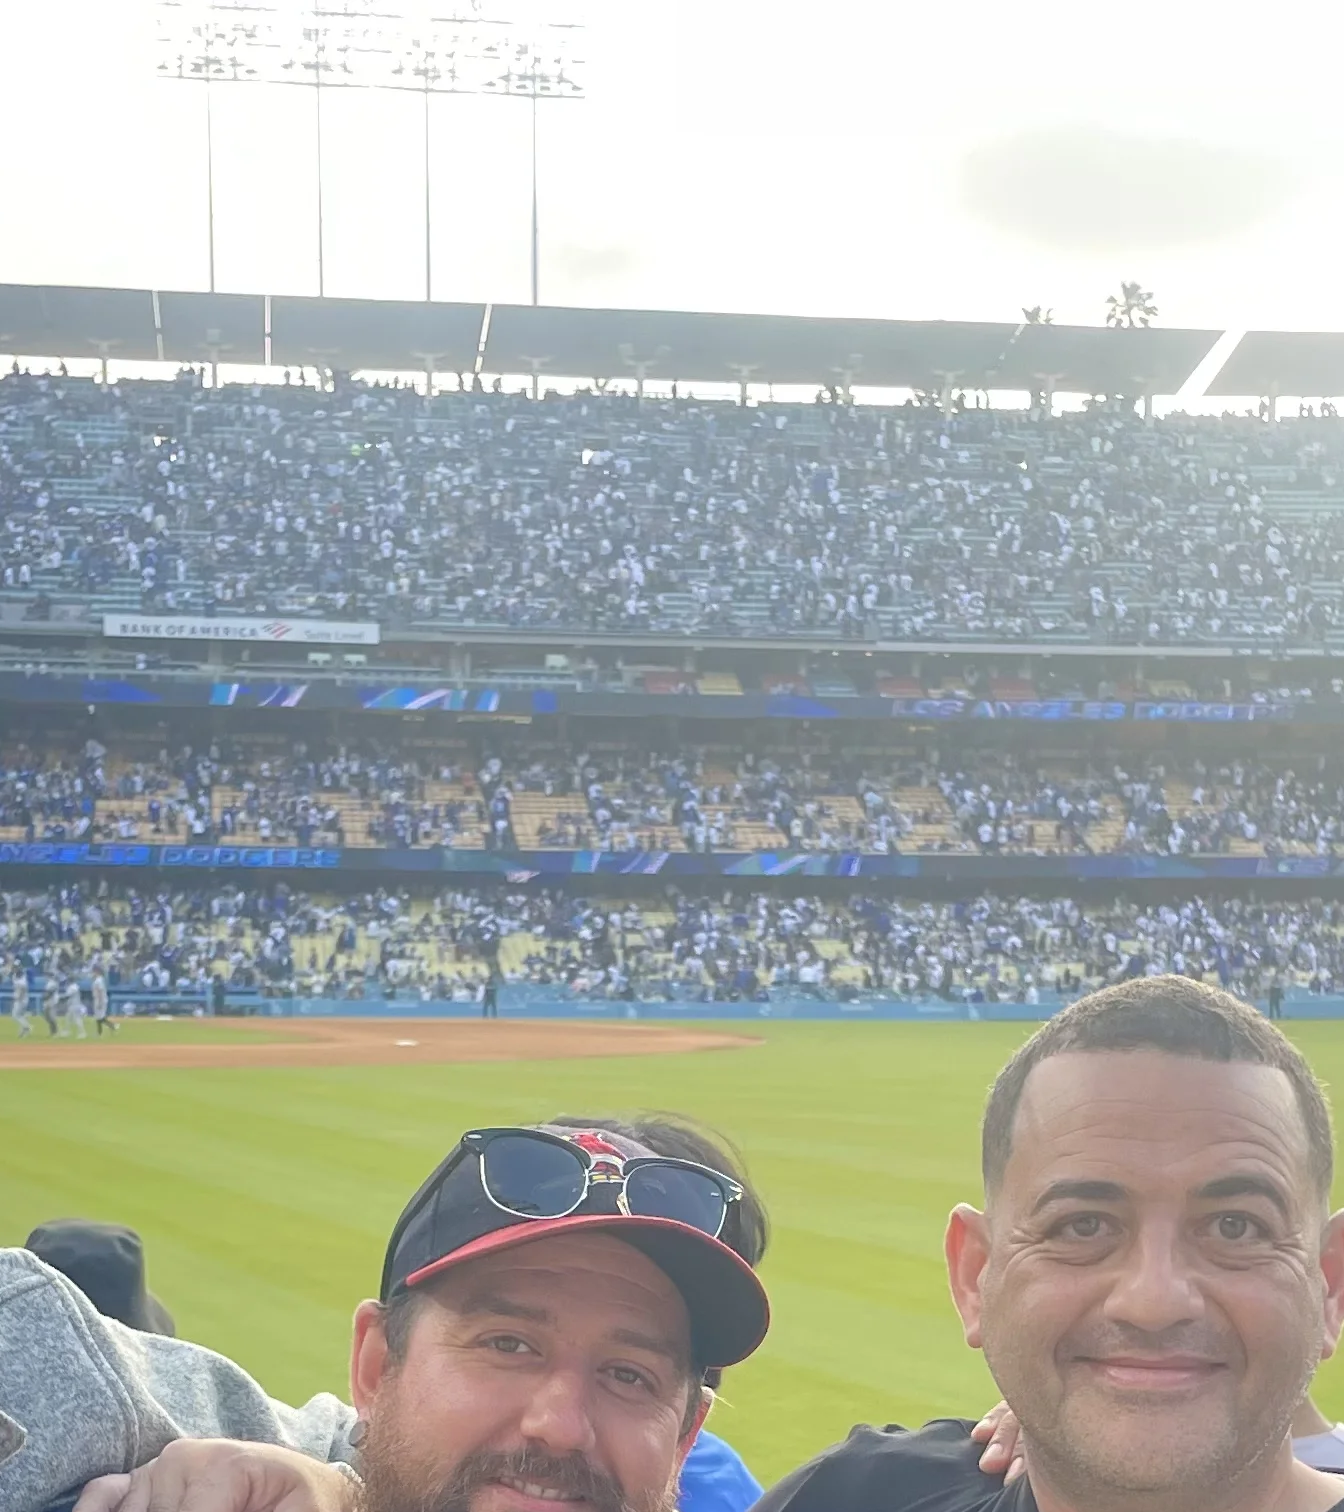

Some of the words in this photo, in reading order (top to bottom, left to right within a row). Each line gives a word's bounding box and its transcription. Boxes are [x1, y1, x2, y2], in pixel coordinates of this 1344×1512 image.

[120, 623, 161, 636] BANK
[165, 625, 186, 637] OF
[189, 626, 260, 639] AMERICA
